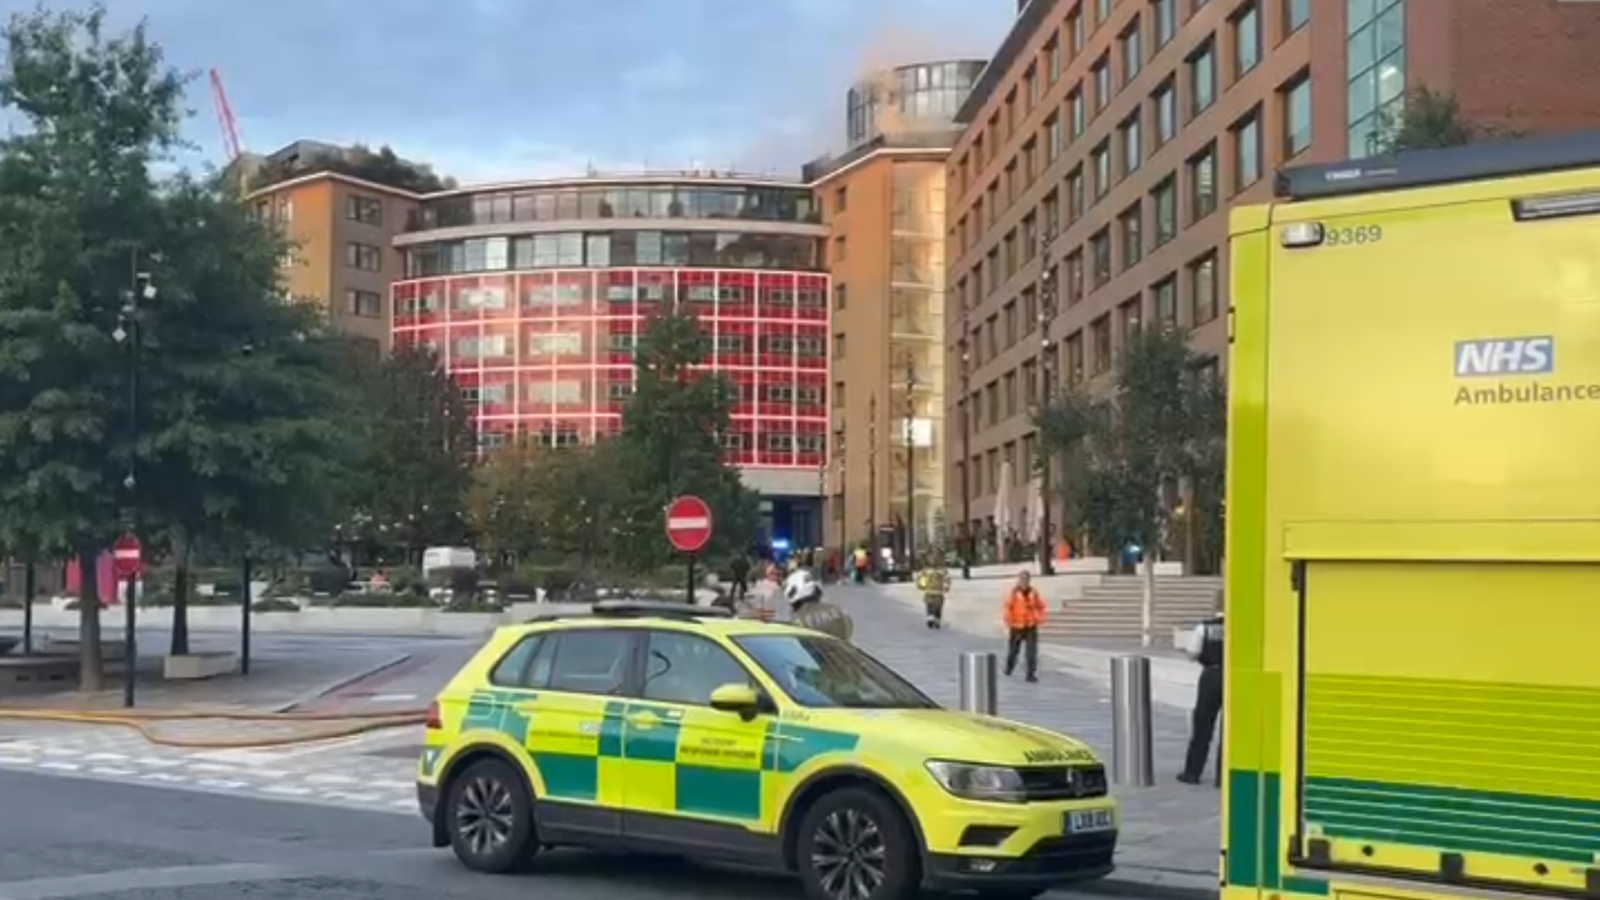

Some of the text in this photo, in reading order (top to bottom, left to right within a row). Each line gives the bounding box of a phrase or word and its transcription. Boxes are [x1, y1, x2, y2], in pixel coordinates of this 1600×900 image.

[1325, 224, 1382, 246] 9369
[1458, 338, 1549, 373] NHS
[1454, 381, 1600, 405] Ambulance
